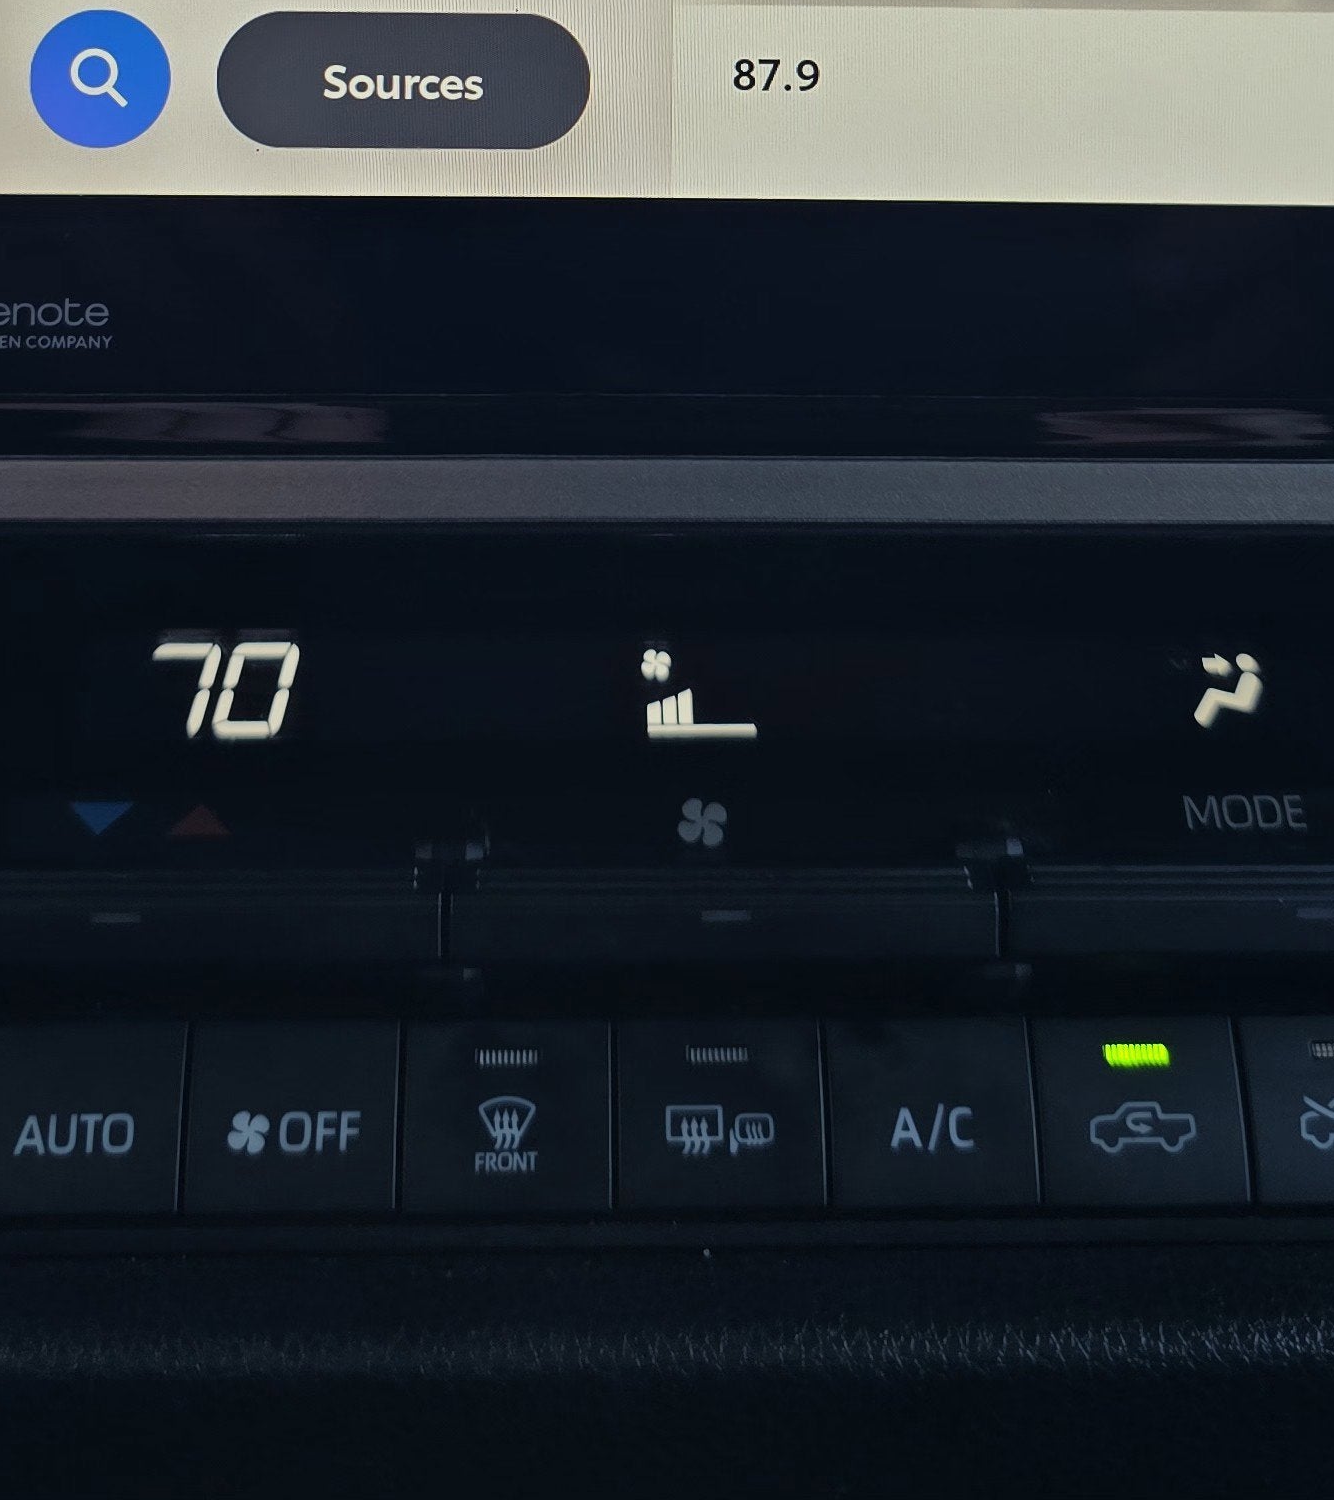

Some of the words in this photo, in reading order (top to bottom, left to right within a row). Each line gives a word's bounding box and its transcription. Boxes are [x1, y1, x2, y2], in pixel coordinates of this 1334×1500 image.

[323, 64, 484, 101] Sources
[733, 58, 820, 92] 87.9
[25, 335, 113, 349] COMPANY
[151, 642, 301, 739] 70
[1183, 794, 1307, 832] MODE
[12, 1112, 135, 1156] AUTO
[278, 1111, 361, 1152] OFF
[890, 1104, 974, 1150] A/C
[474, 1151, 538, 1172] FRONT
